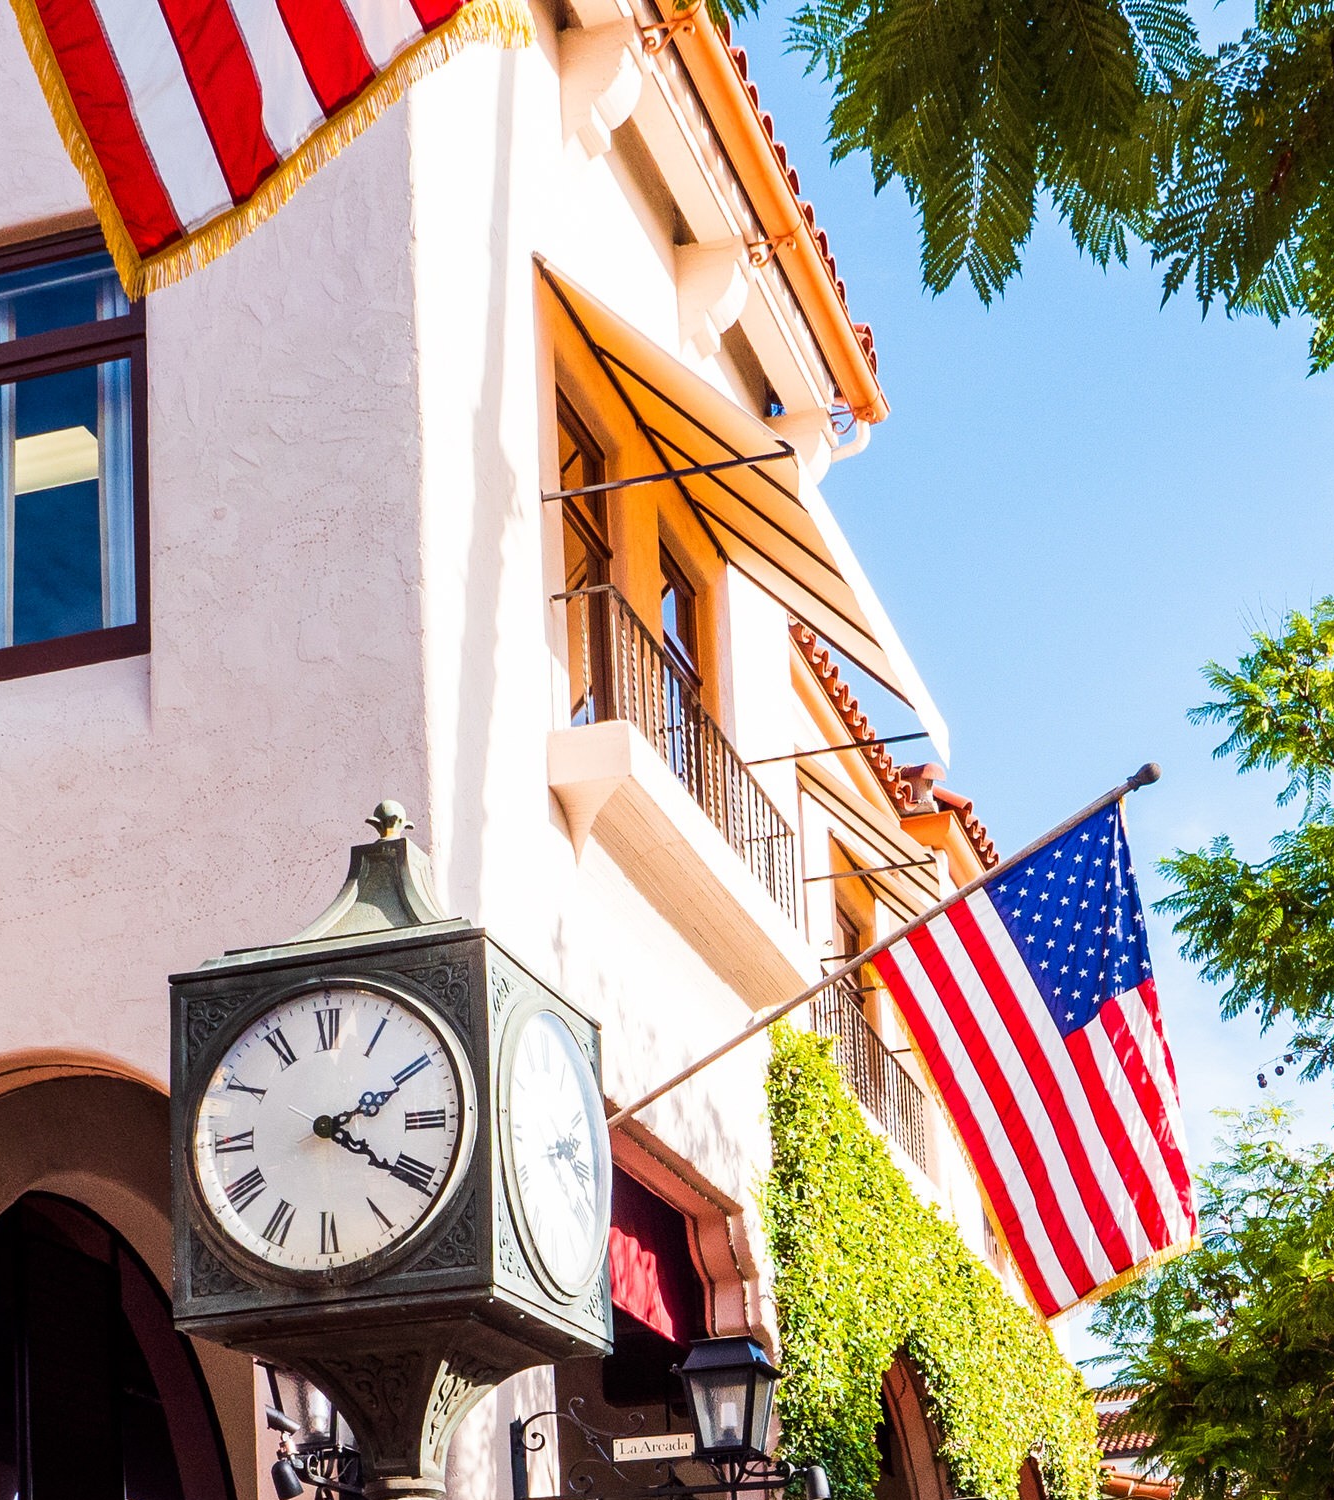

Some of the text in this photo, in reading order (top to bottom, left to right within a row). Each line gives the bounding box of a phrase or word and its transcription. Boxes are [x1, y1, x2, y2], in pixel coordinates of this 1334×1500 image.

[387, 1150, 437, 1192] III
[619, 1437, 689, 1455] La Arcada
